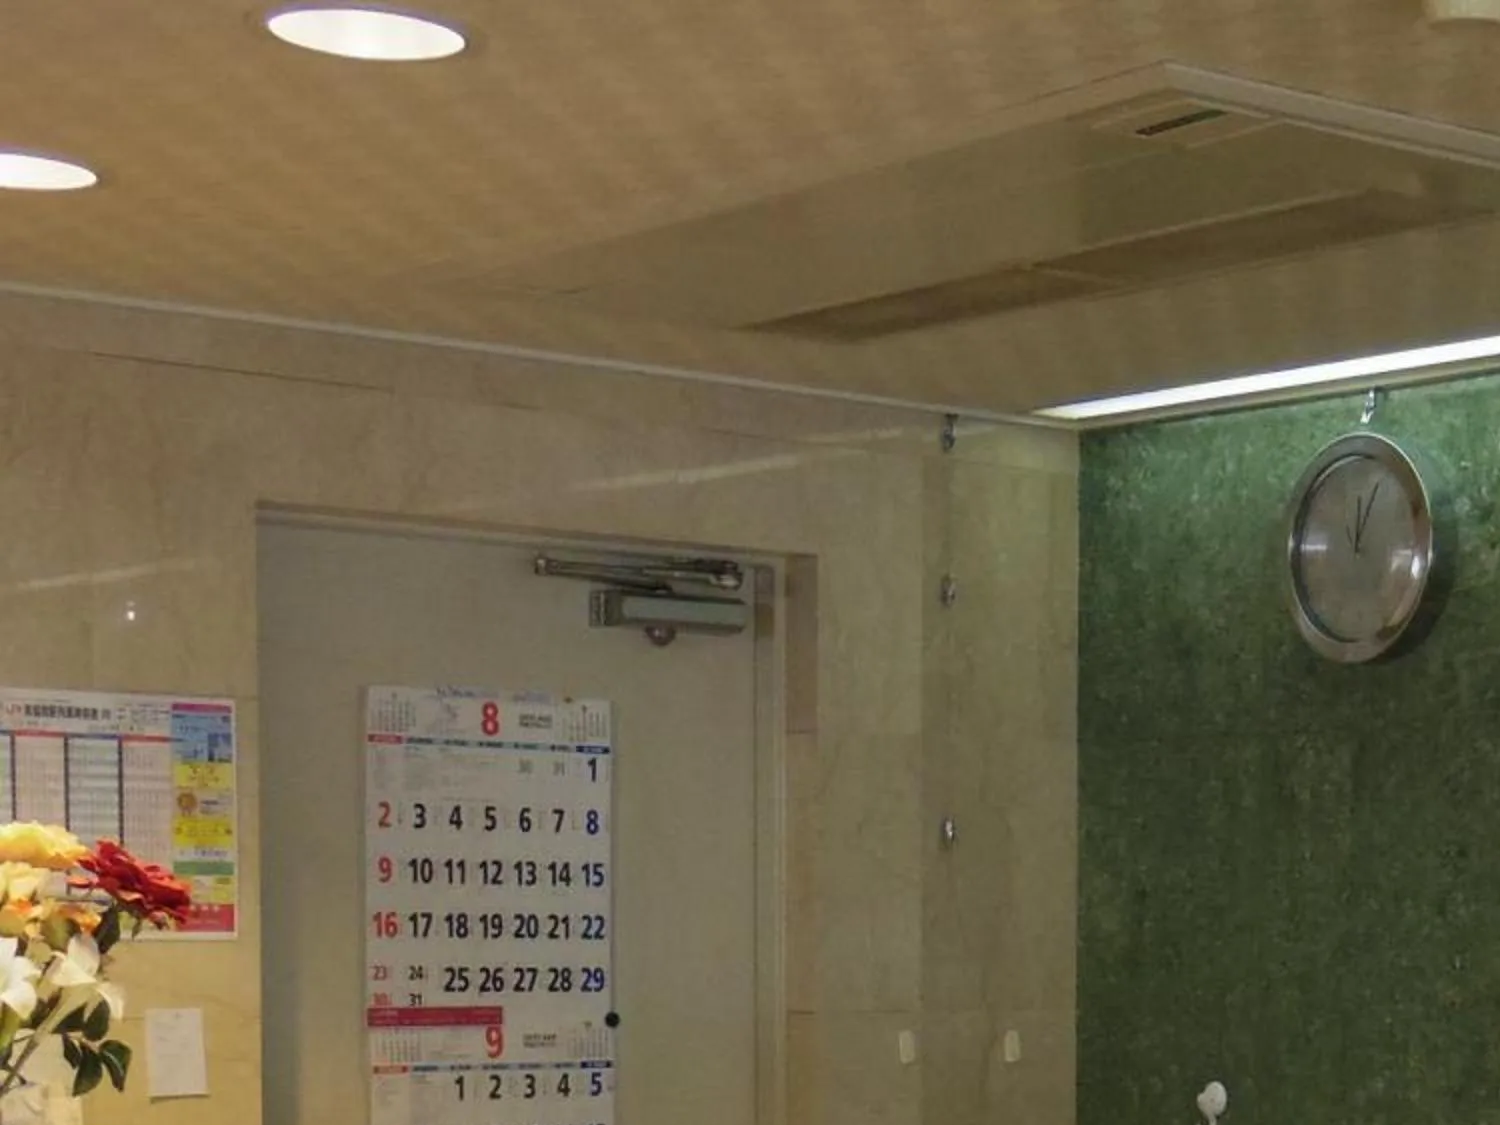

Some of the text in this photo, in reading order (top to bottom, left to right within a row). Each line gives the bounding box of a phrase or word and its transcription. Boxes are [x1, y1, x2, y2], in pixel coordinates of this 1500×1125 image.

[481, 701, 500, 736] 8
[587, 757, 598, 783] 1
[377, 801, 599, 836] 2 3 4 5 6 7 8
[378, 856, 605, 888] 9 10 11 12 13 14 15
[372, 911, 605, 941] 16 17 18 19 20 21 22
[372, 965, 605, 993] 23 24 25 26 27 28 29
[409, 992, 424, 1006] 31
[484, 1025, 504, 1060] 9
[454, 1071, 603, 1101] 1 2 3 4 5
